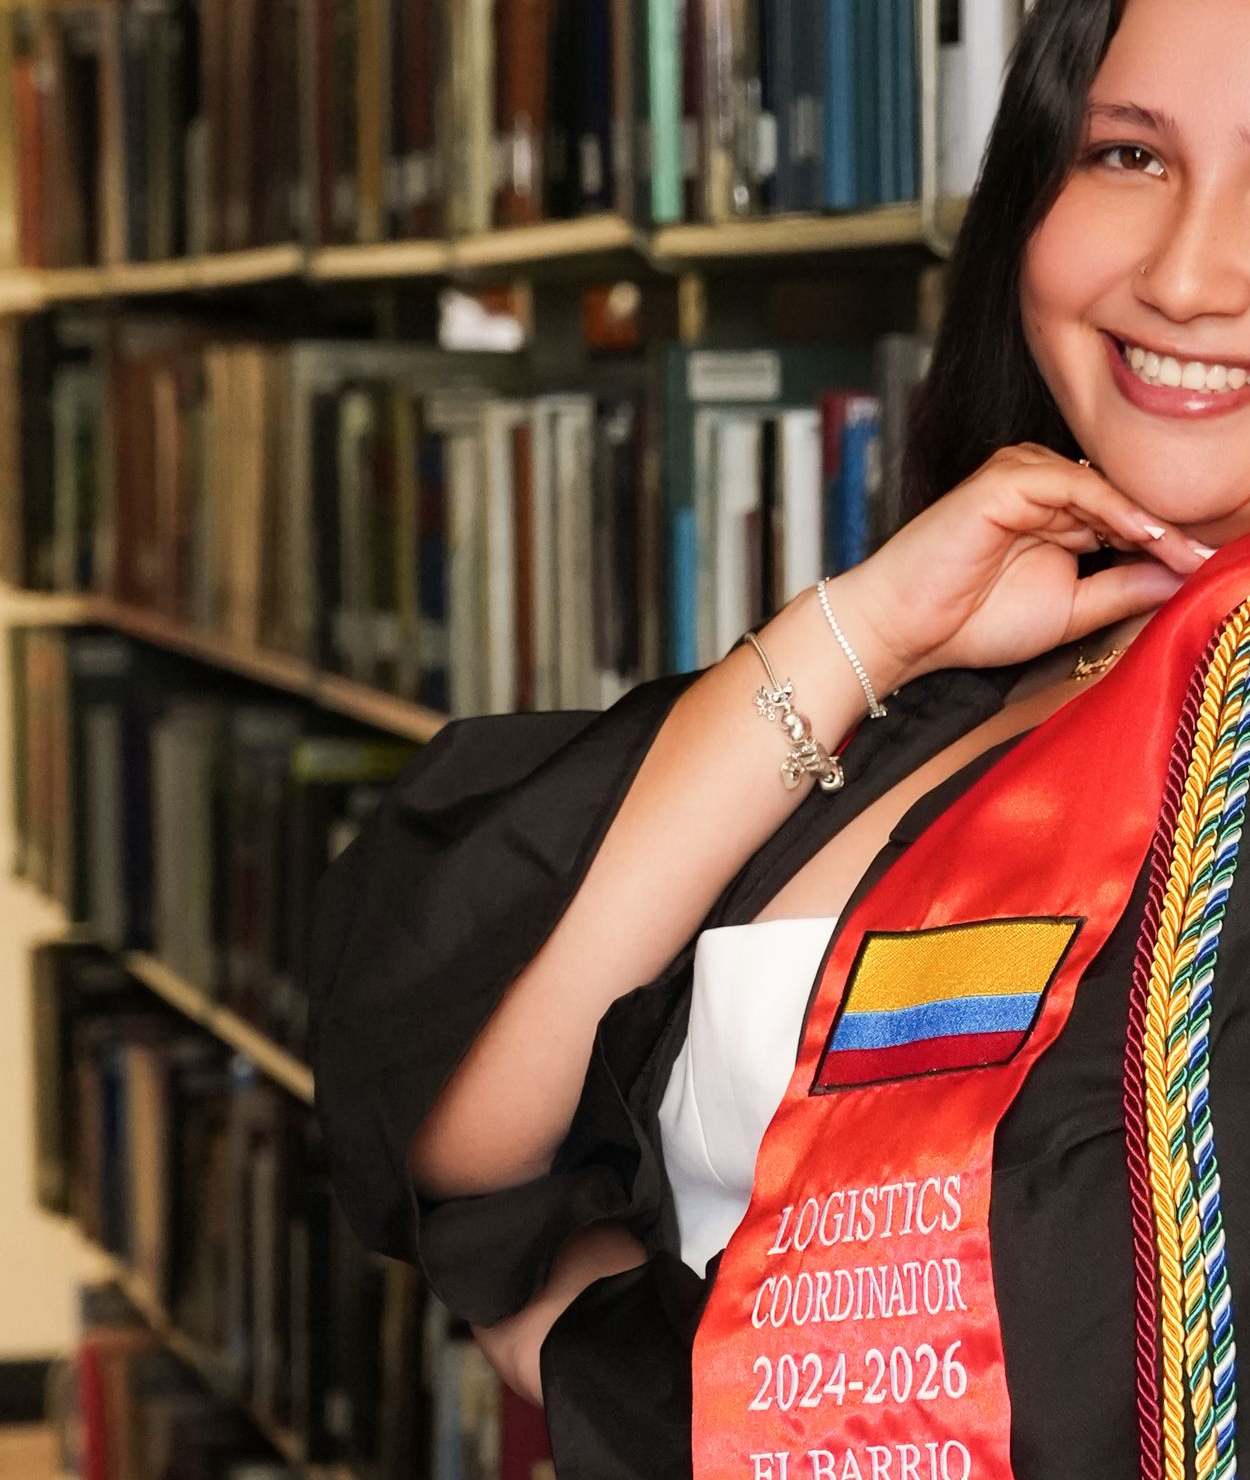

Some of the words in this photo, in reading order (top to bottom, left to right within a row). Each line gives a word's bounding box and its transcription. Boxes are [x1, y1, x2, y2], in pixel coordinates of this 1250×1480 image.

[766, 1173, 963, 1257] LOGISTICS
[751, 1257, 969, 1330] COORDINATOR
[747, 1339, 969, 1412] 2024-2026
